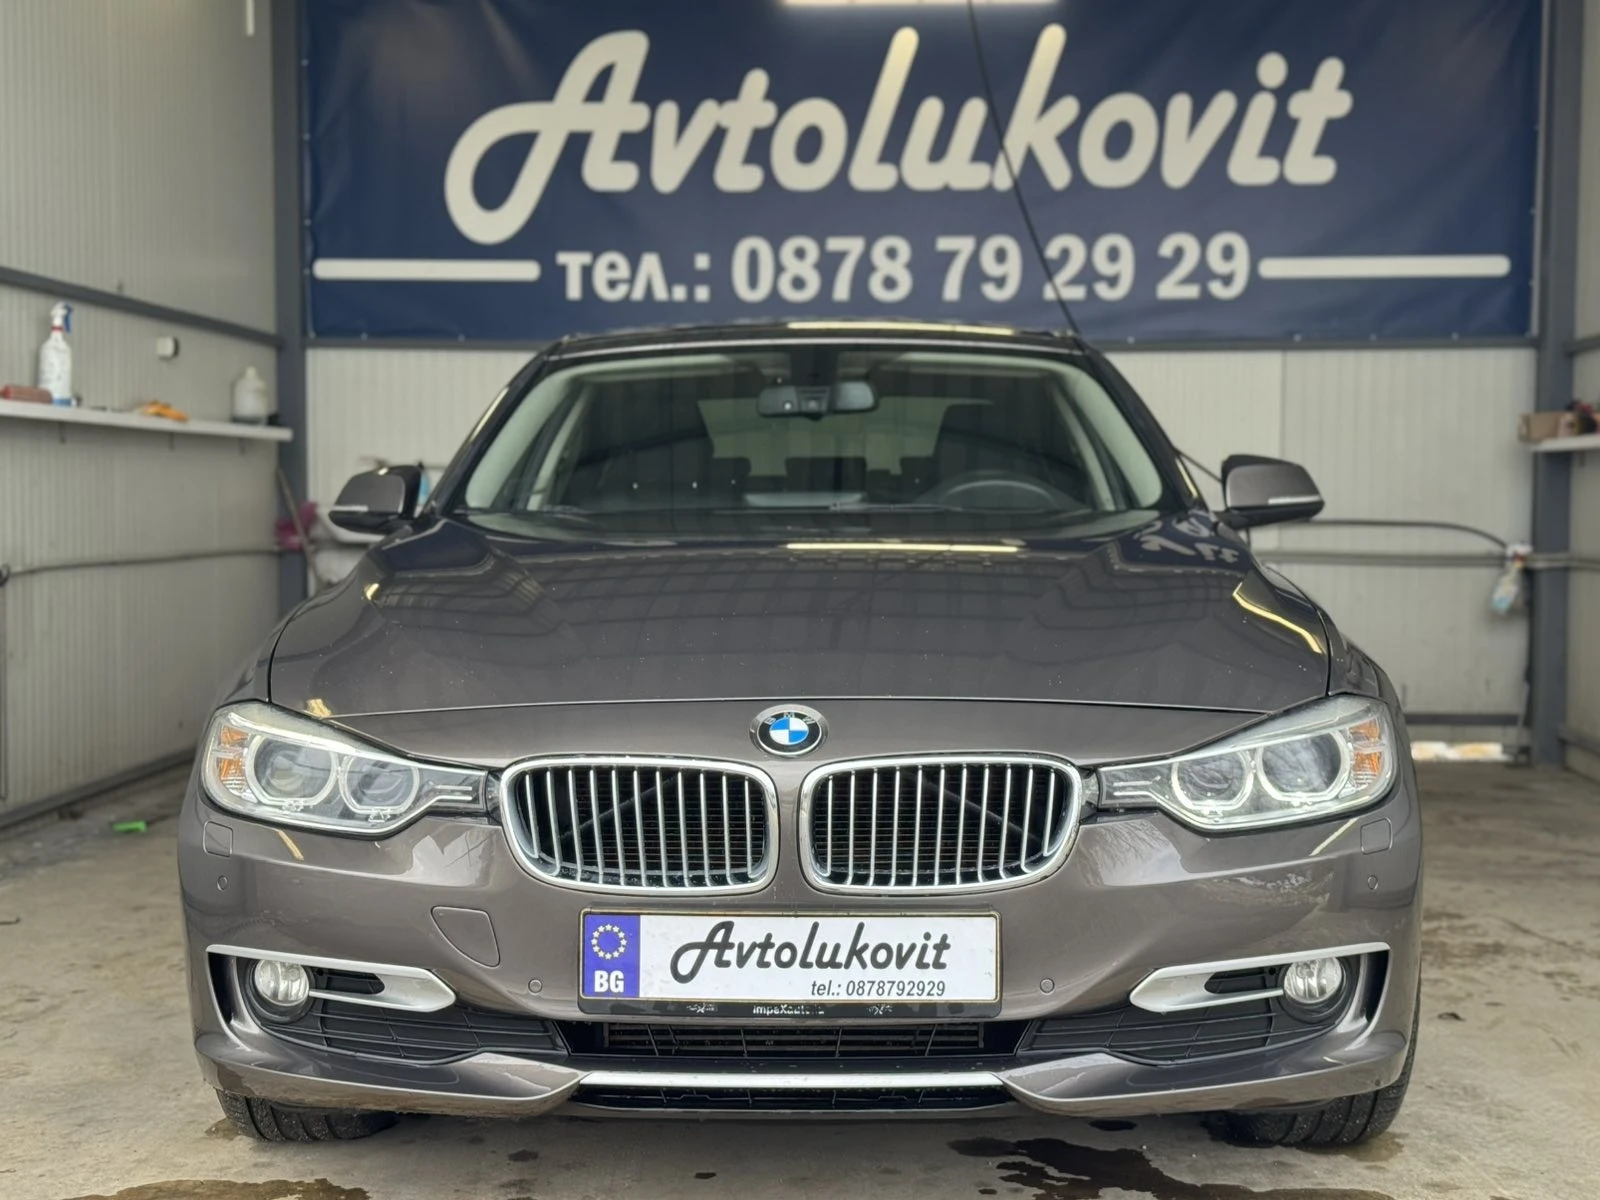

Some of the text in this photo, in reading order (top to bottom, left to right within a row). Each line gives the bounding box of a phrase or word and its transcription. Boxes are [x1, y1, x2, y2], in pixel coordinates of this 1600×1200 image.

[444, 23, 1353, 245] Avtolukovit
[556, 231, 1250, 302] тел.: 0878 79 29 29
[593, 969, 625, 994] BG
[670, 921, 950, 984] Avtolukovit
[811, 980, 946, 997] tel.: 0878792929
